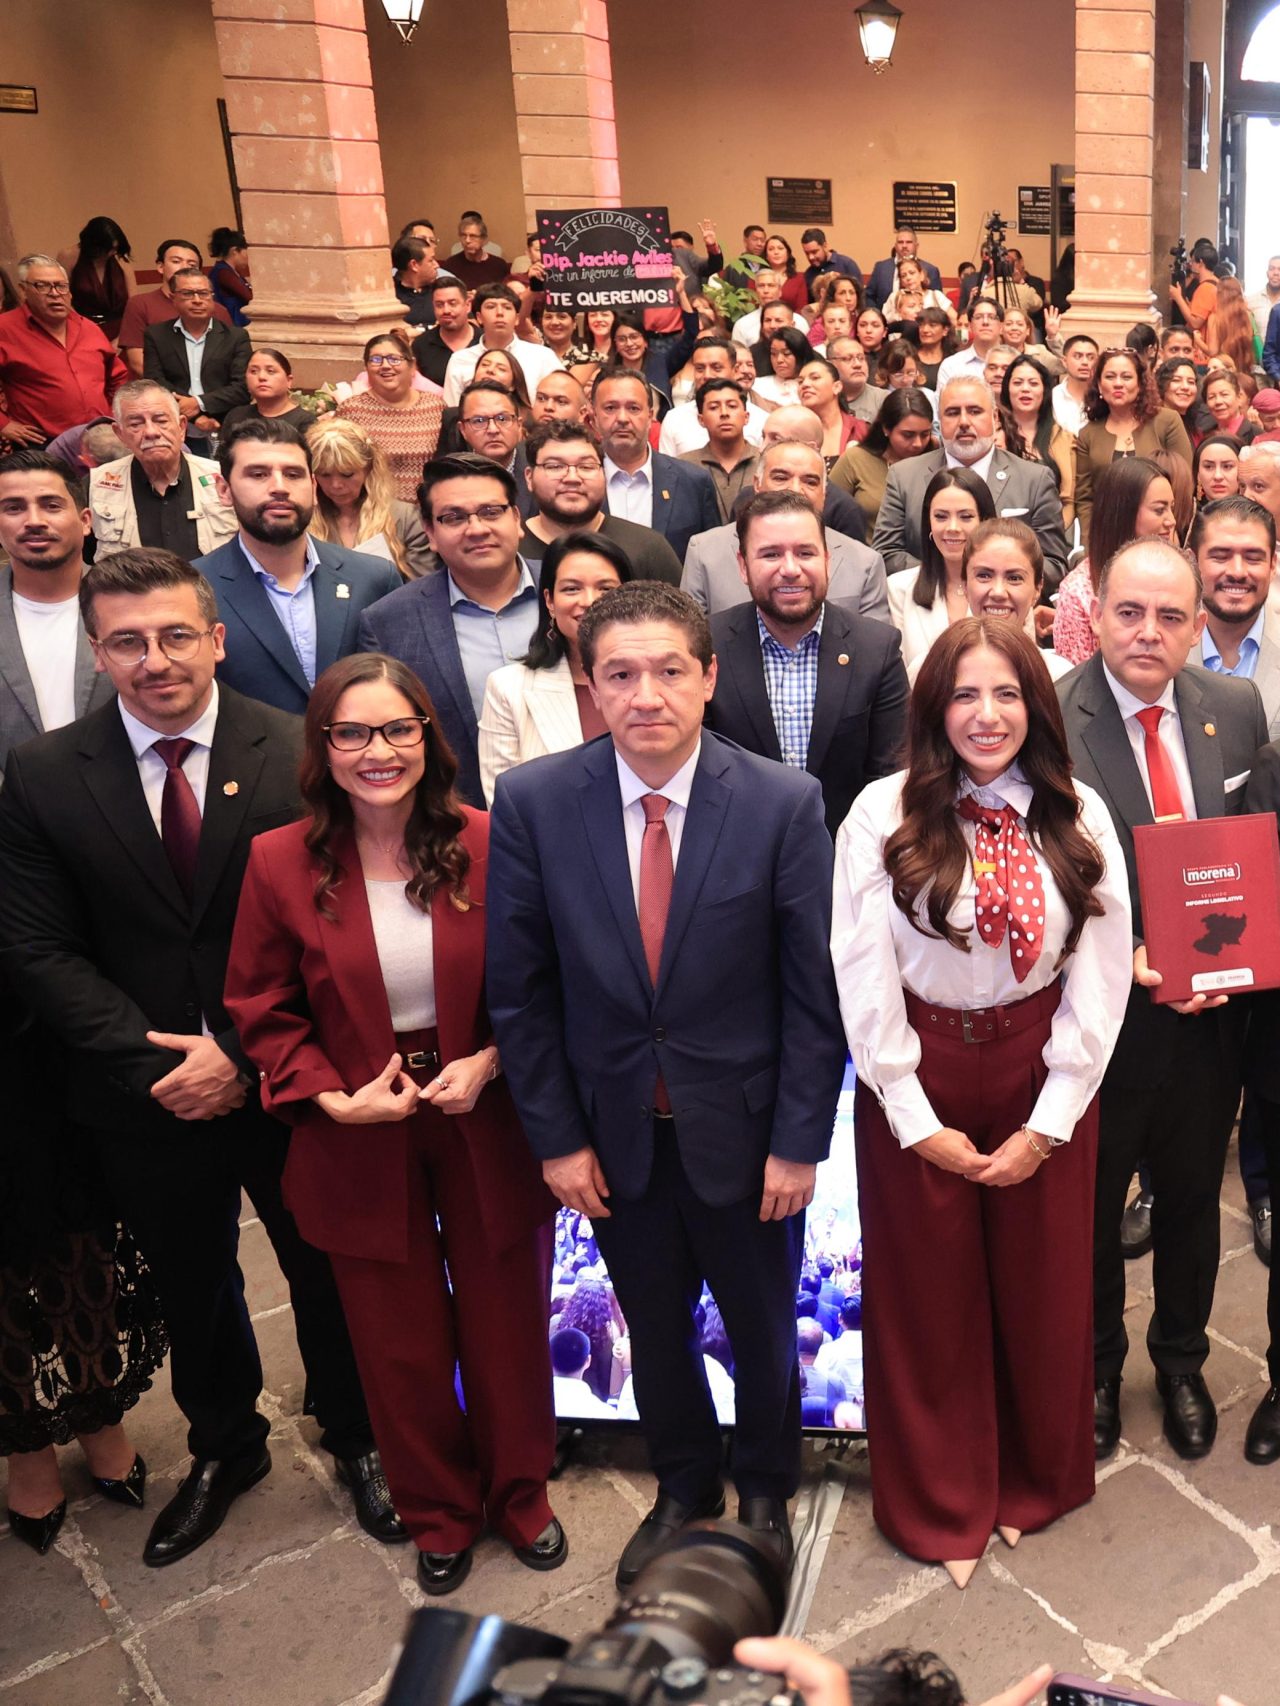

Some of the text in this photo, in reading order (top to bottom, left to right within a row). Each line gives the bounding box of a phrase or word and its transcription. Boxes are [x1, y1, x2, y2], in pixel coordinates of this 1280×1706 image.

[565, 212, 646, 236] FELICIDADES
[543, 253, 573, 271] Dip.
[576, 250, 629, 267] Jackie
[567, 272, 579, 281] un
[577, 289, 674, 306] QUEREMOS!
[1187, 867, 1236, 881] morena
